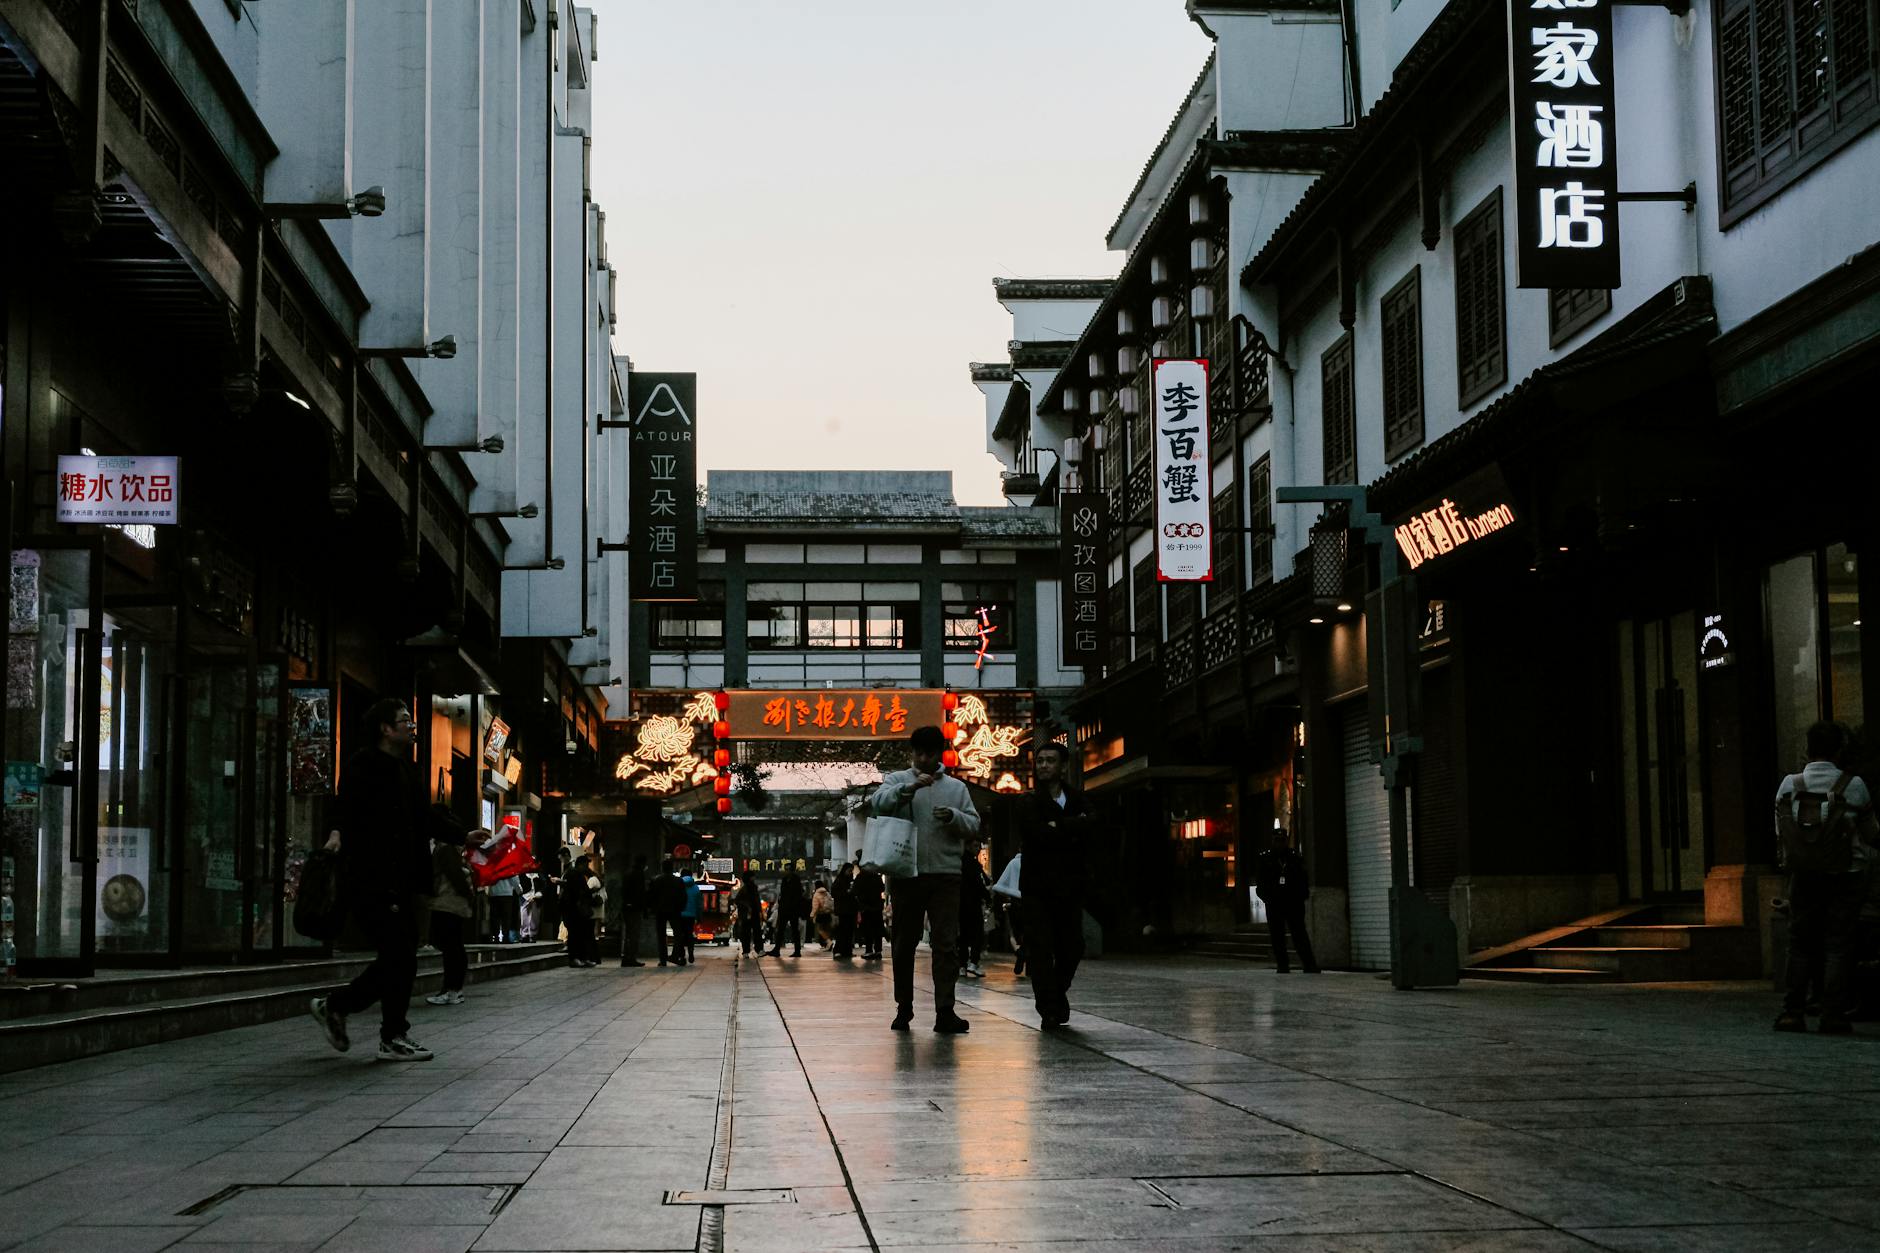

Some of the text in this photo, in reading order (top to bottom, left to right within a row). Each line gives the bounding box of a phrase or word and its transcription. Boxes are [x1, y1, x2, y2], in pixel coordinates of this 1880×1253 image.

[1530, 0, 1605, 248] 家酒店
[635, 431, 692, 442] ATOUR
[1161, 381, 1201, 504] 李百蟹
[59, 472, 173, 503] 糖水饮品
[649, 454, 677, 588] 亚朵酒店
[1395, 498, 1469, 570] 如家酒店
